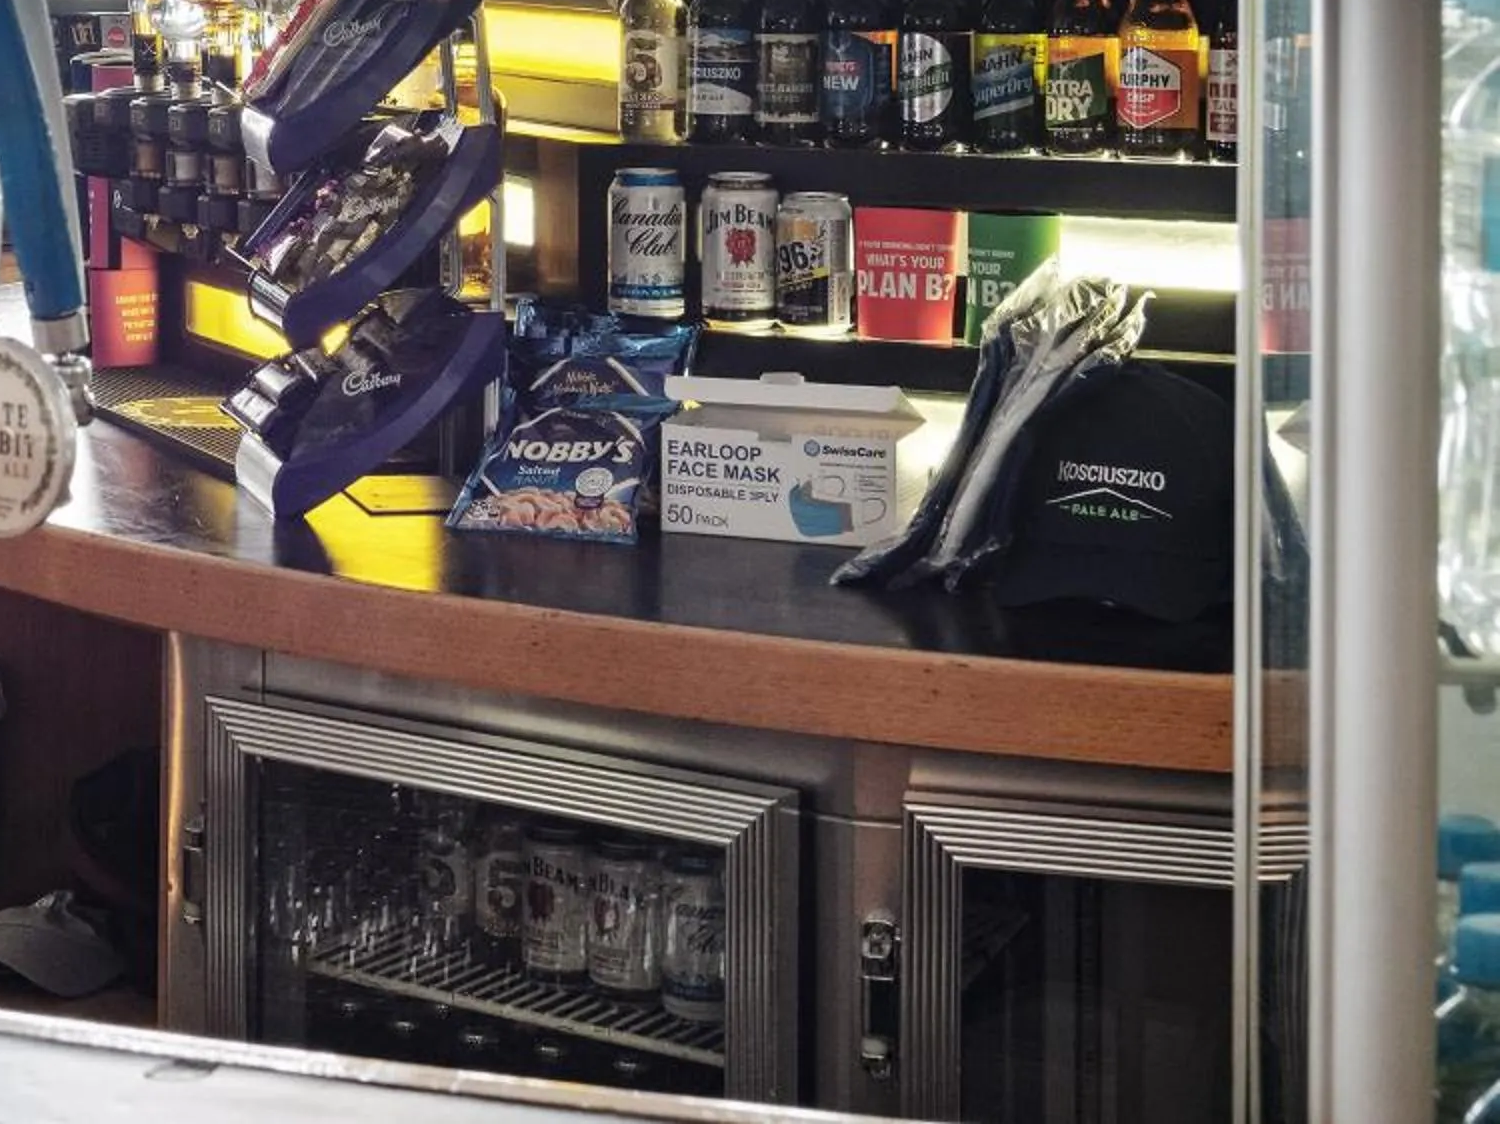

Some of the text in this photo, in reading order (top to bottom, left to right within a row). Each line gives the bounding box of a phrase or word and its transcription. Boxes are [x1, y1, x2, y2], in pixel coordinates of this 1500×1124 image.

[706, 209, 731, 234] JIM
[866, 253, 946, 270] WHAT'S YOUR
[857, 270, 917, 301] PLAN
[925, 273, 955, 302] B?
[342, 370, 402, 396] Cadbury
[504, 436, 635, 463] NOBBY'S
[668, 439, 762, 462] EARLOOP
[821, 444, 888, 460] SwissCare
[667, 459, 781, 484] FACE MASK
[1057, 460, 1166, 492] KOSCIUSZKO
[667, 483, 746, 501] DISPOSABLE
[667, 504, 730, 529] 50 PACK
[1071, 503, 1140, 521] PALE ALE
